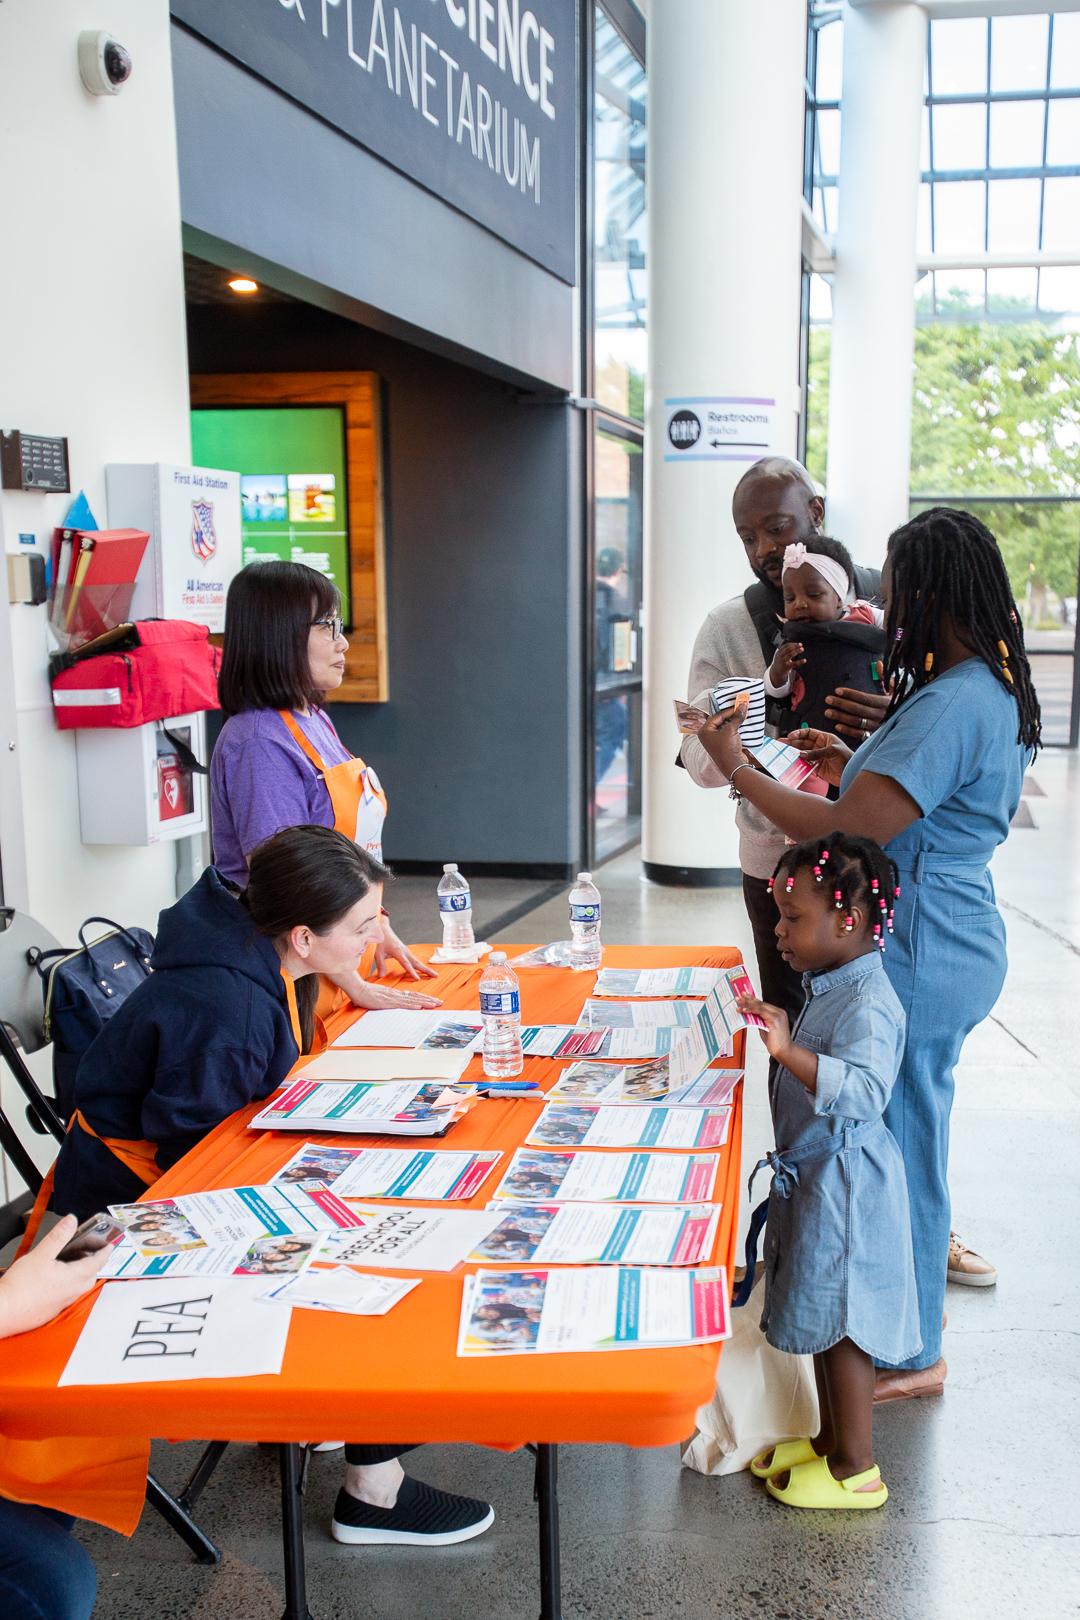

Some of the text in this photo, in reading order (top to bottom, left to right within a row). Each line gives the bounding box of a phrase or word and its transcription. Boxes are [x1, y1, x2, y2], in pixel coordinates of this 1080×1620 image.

[707, 411, 769, 424] Restrooms
[174, 471, 229, 490] First Aid Station
[335, 1211, 412, 1261] PRESCHOOL
[371, 1219, 427, 1255] FOR ALL
[121, 1294, 214, 1362] PFA
